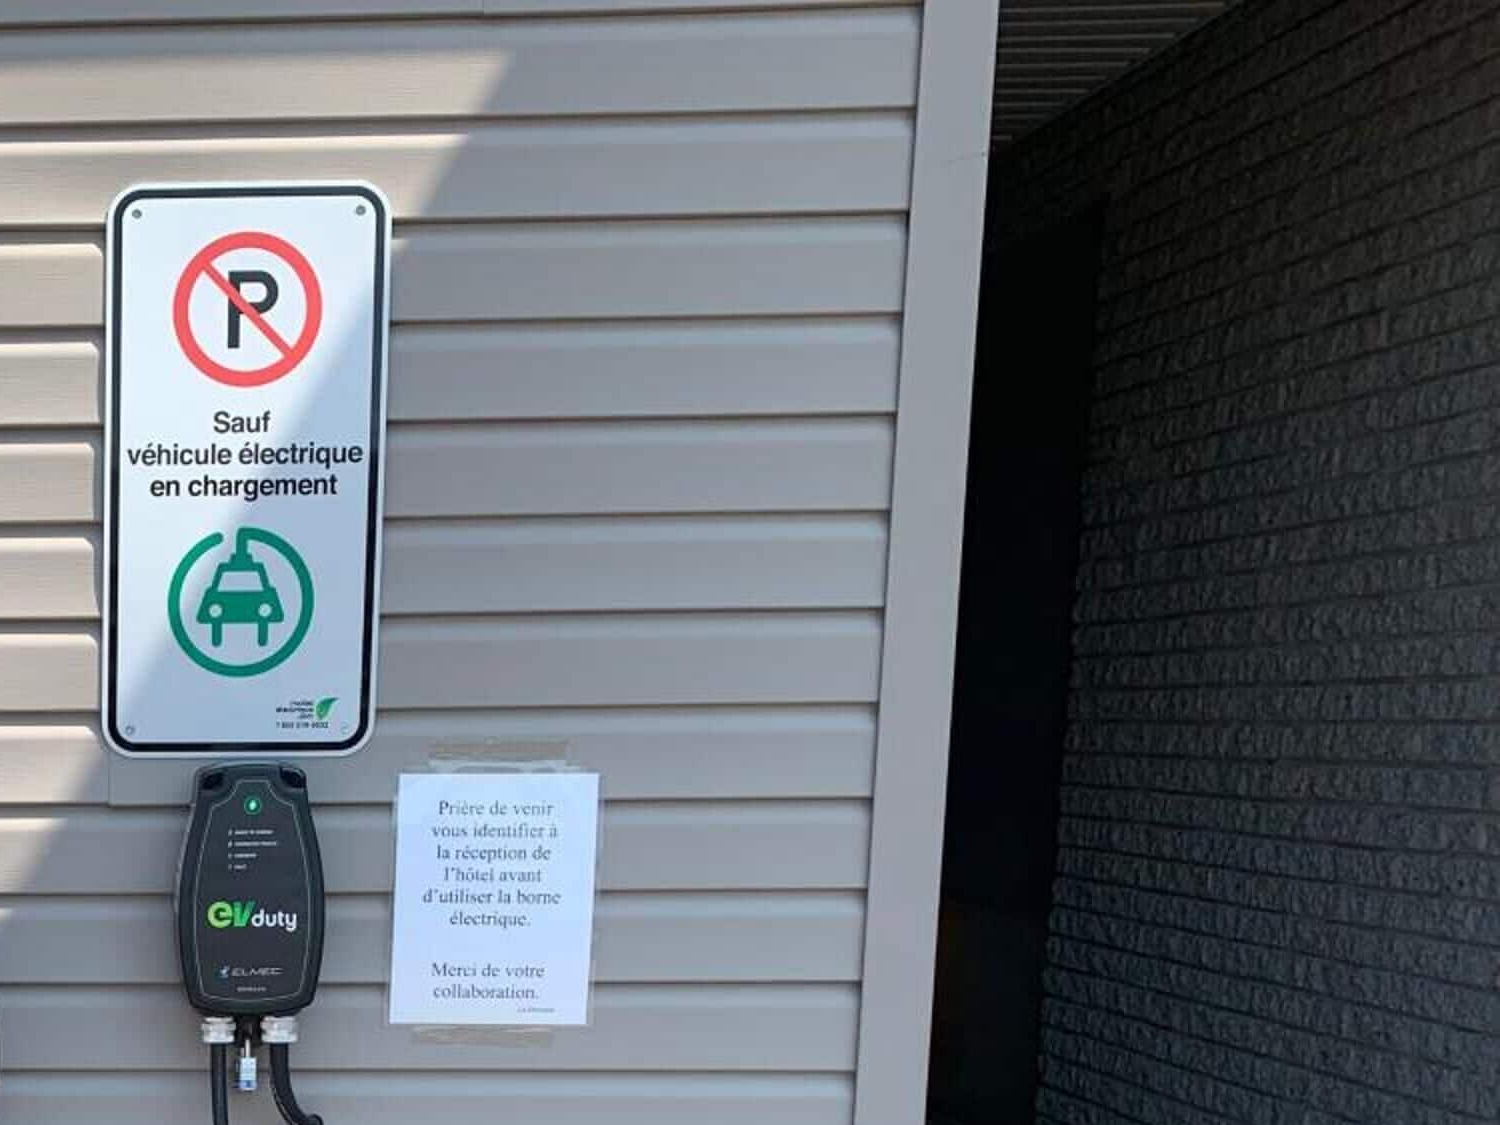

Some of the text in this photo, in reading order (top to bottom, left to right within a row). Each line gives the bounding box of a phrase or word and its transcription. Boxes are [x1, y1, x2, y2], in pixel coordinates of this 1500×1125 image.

[227, 269, 279, 349] P
[213, 410, 272, 434] Sauf
[127, 441, 364, 472] véhicule électrique
[149, 474, 338, 501] en chargement
[437, 800, 554, 816] Prière de venir
[431, 822, 558, 838] vous identifier à
[436, 845, 552, 864] la réception de
[443, 867, 542, 882] l'hôtel avant
[422, 888, 562, 904] d'utiliser la borne
[449, 910, 532, 929] électrique.
[431, 962, 545, 977] Merci de votre
[432, 983, 539, 999] collaboration.
